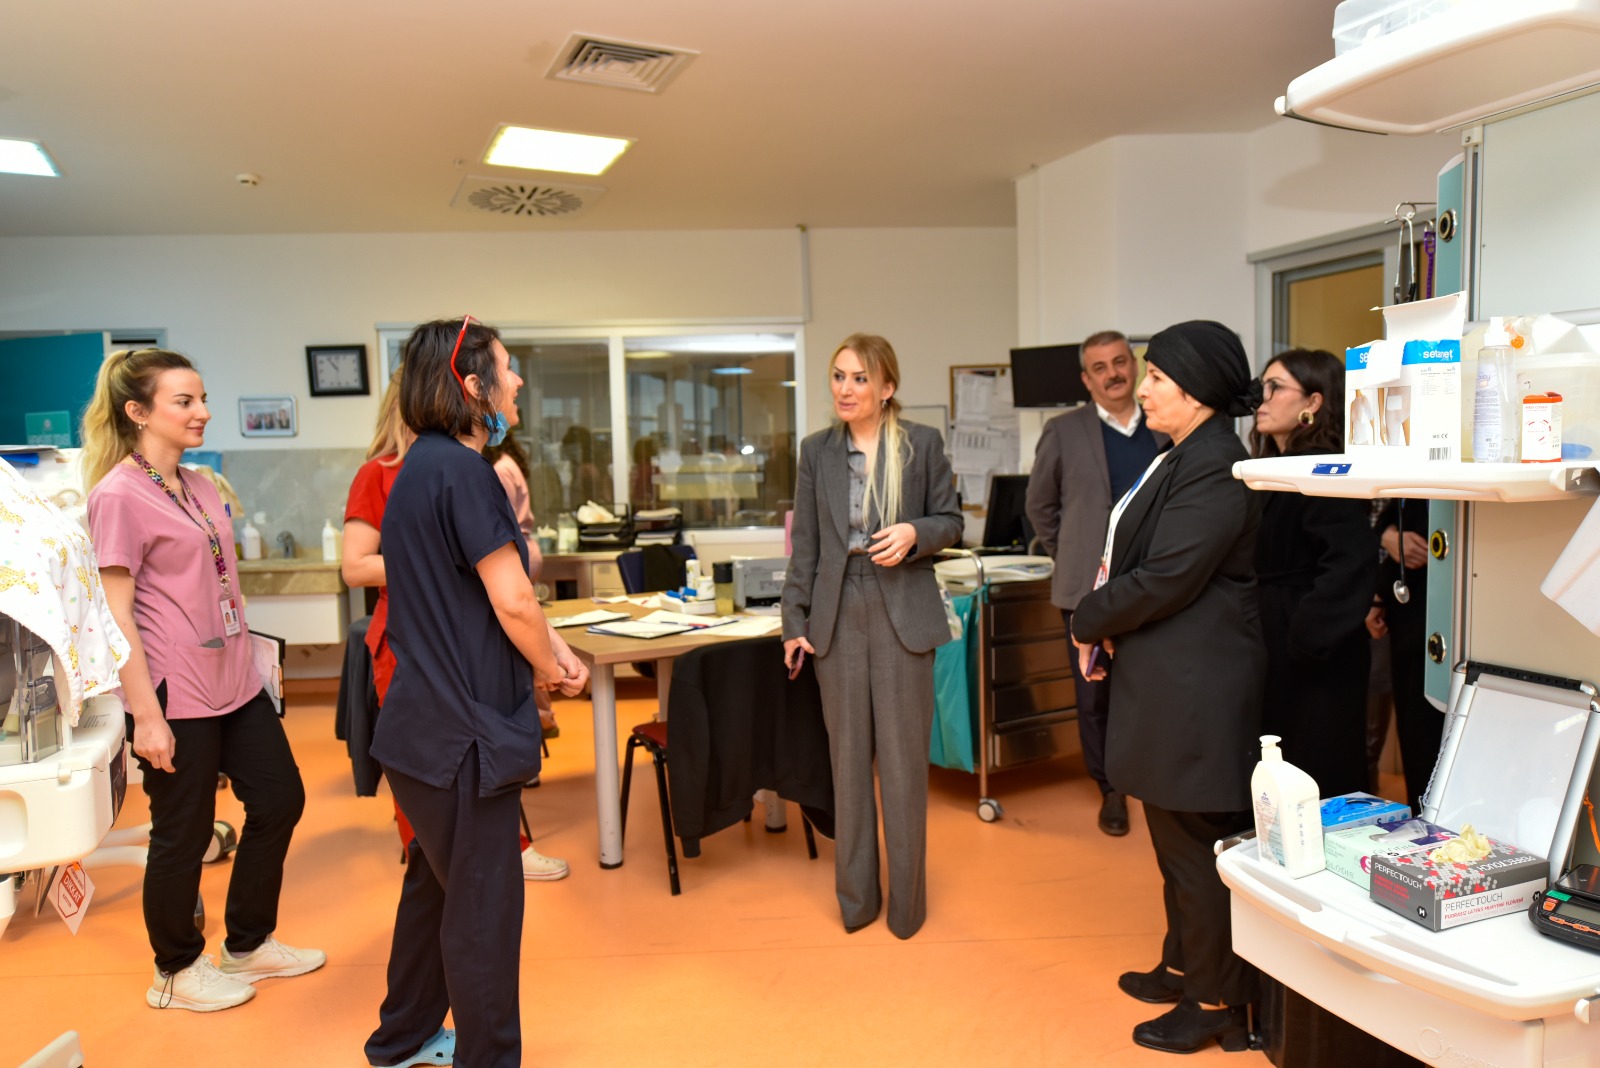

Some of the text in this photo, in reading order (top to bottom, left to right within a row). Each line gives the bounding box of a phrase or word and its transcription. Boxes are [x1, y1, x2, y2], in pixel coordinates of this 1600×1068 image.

[1477, 855, 1536, 872] PERFECTOUCH
[1374, 862, 1422, 891] PERFECTOUCH
[1445, 892, 1503, 912] PERFECTOUCH
